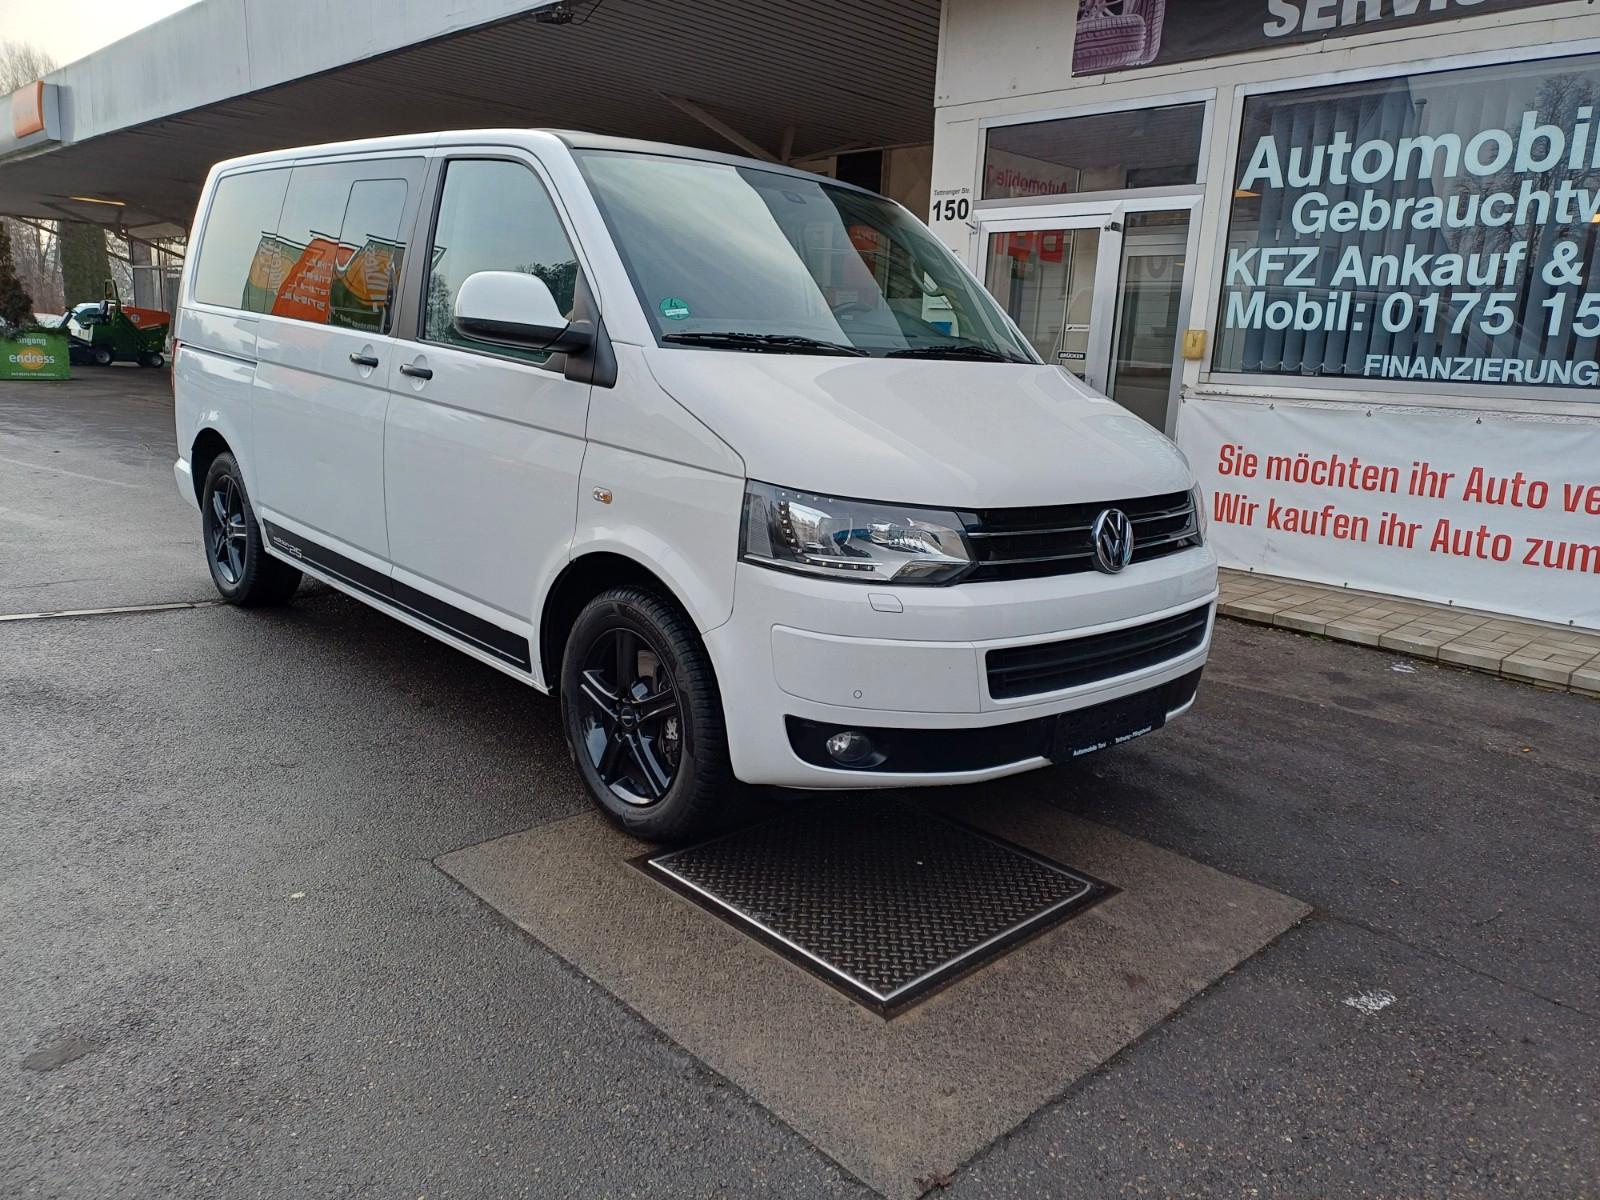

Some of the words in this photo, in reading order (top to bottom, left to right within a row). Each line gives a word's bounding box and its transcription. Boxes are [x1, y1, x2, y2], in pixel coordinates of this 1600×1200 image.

[932, 198, 969, 221] 150
[1226, 246, 1320, 287] KFZ
[1330, 240, 1528, 287] Ankauf
[1541, 240, 1584, 286] &
[1225, 291, 1365, 332] Mobil:
[1381, 291, 1518, 336] 0175
[1541, 291, 1600, 339] 15
[8, 352, 55, 364] endress
[1363, 353, 1600, 387] FINANZIERUNG
[1218, 443, 1258, 478] Sie
[1266, 452, 1399, 494] möchten
[1408, 461, 1455, 499] ihr
[1462, 466, 1549, 509] Auto
[289, 544, 302, 559] 25
[1213, 491, 1260, 526] Wir
[1266, 498, 1369, 542] kaufen
[1378, 511, 1423, 549] ihr
[1430, 518, 1512, 562] Auto
[1522, 537, 1600, 574] zum
